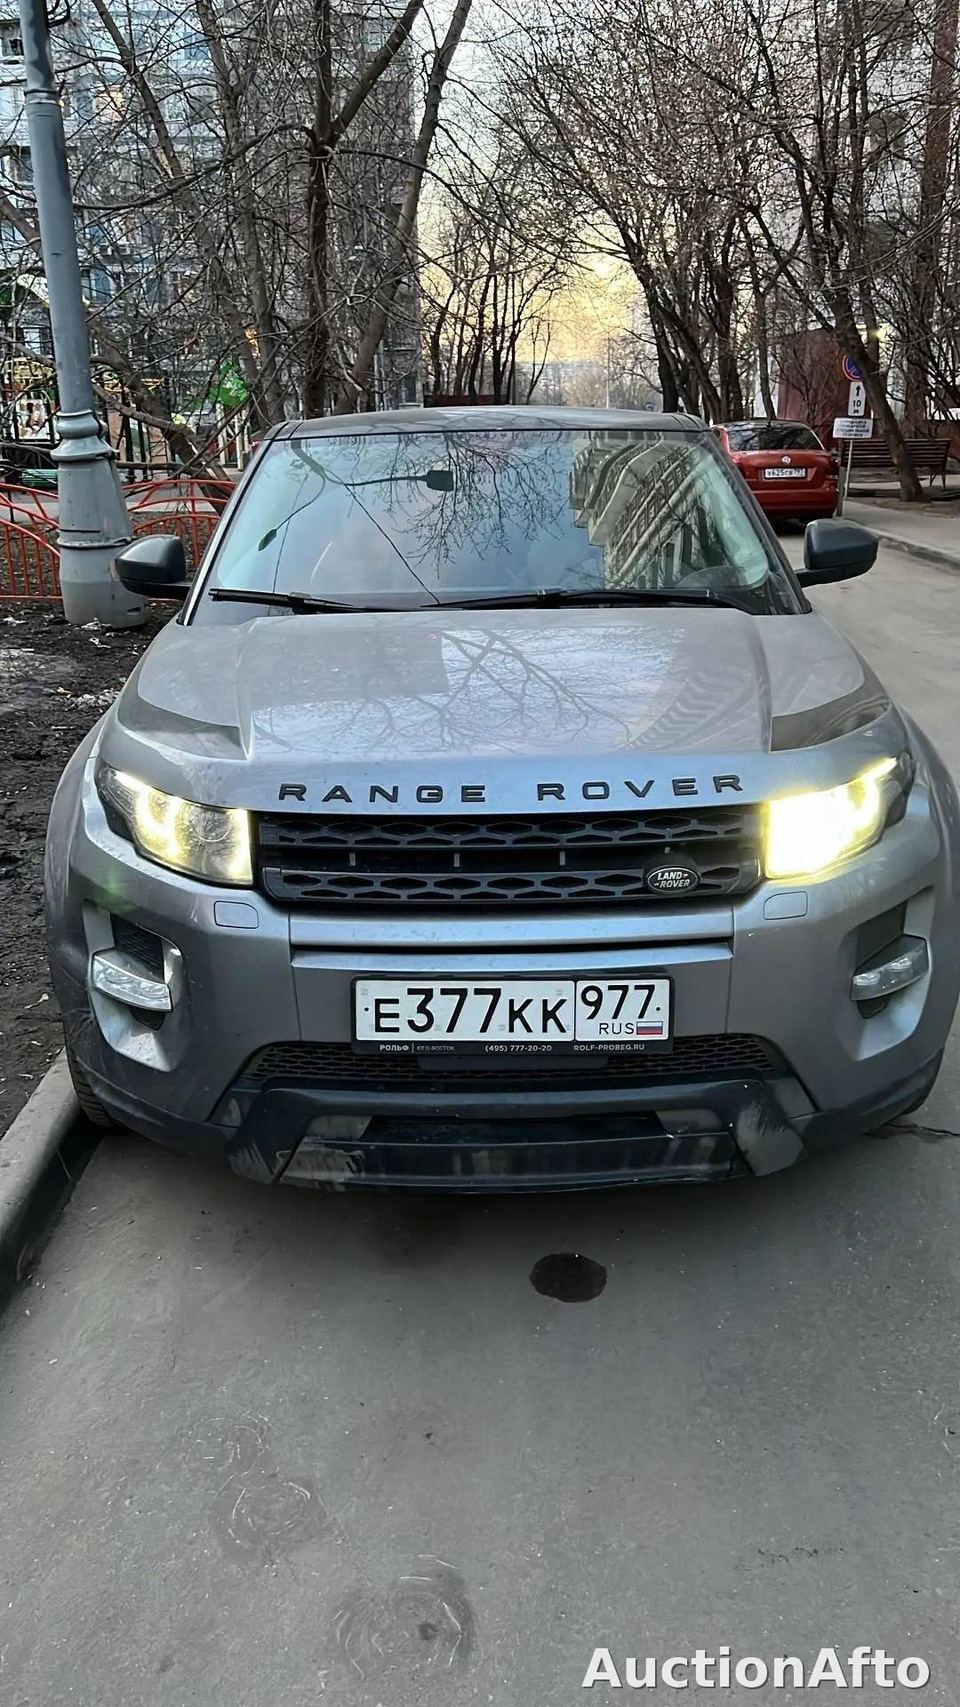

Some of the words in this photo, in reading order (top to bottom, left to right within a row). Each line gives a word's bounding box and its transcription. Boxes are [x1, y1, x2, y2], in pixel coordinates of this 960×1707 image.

[279, 783, 486, 803] RANGE
[537, 774, 743, 801] ROVER
[374, 987, 568, 1033] Е377КК
[580, 984, 656, 1020] 977
[598, 1022, 635, 1035] RUS
[485, 1044, 508, 1052] (495)
[573, 1043, 645, 1051] ROLF-PROBEG.RU
